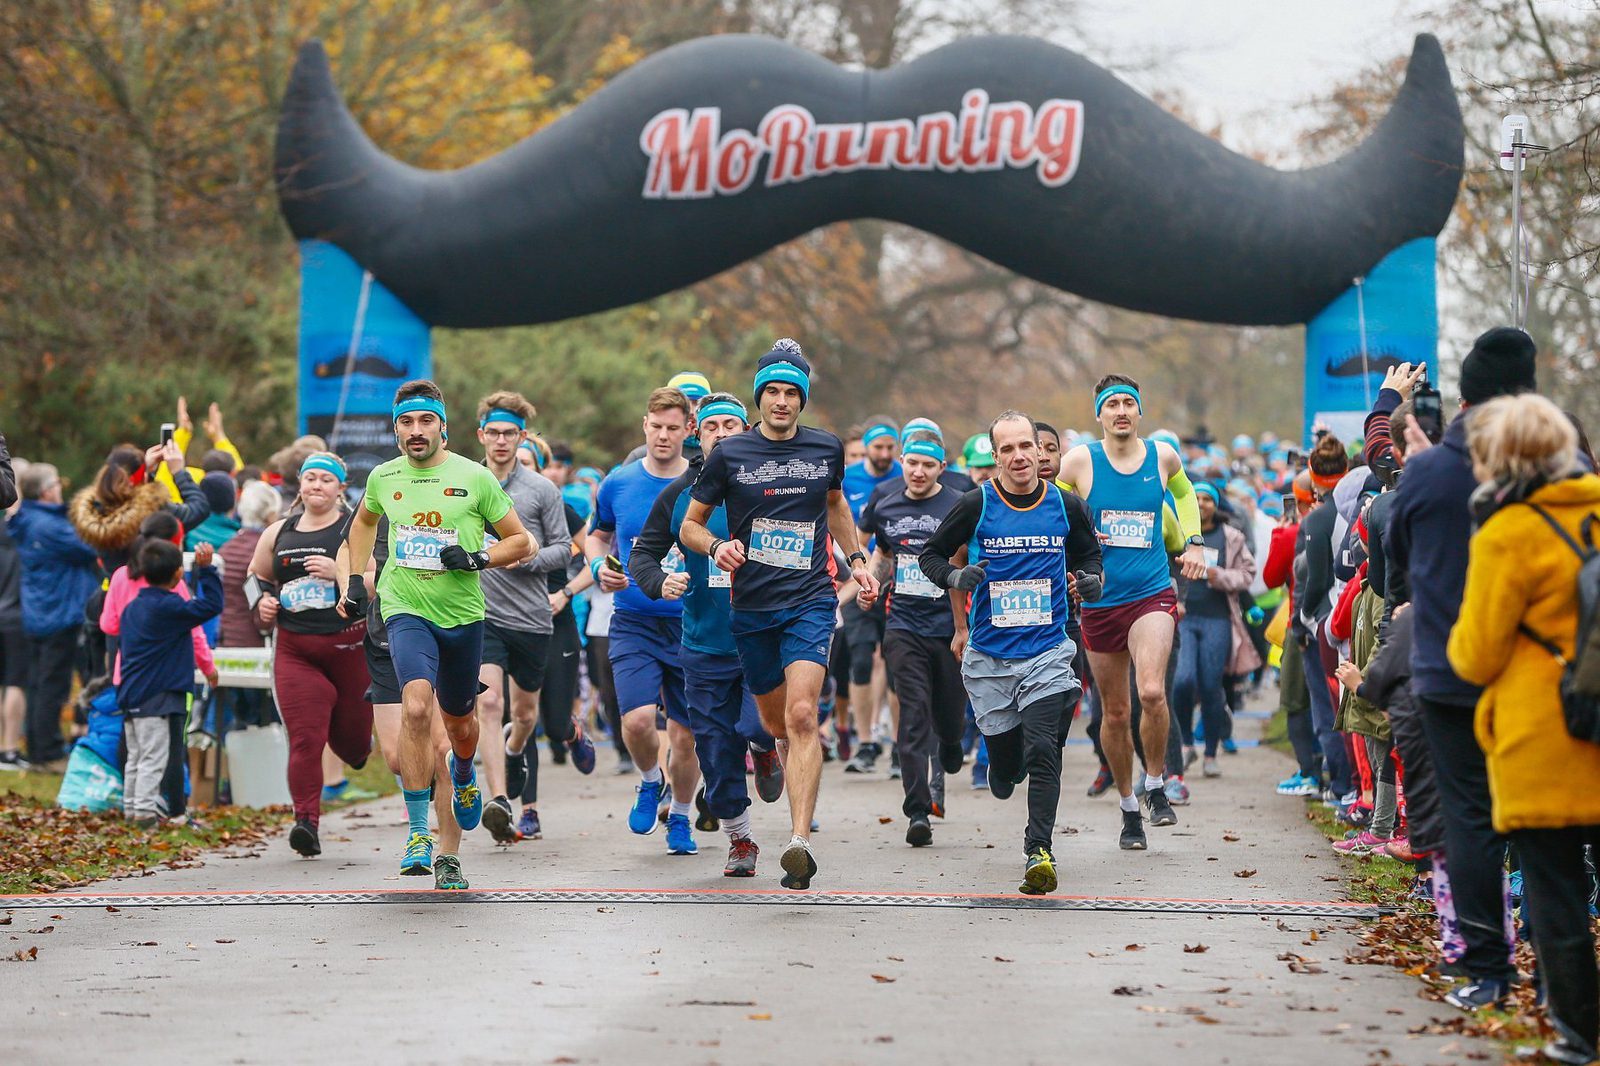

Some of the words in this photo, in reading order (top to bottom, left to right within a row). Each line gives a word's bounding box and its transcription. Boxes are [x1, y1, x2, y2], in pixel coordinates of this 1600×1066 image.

[640, 88, 1084, 199] MoRunning
[764, 487, 807, 496] MORUNNING
[412, 511, 442, 528] 20
[1110, 524, 1147, 537] 0090
[761, 534, 805, 551] 0078
[1051, 536, 1064, 547] UK
[289, 586, 325, 602] 0143
[1001, 595, 1041, 609] 0111
